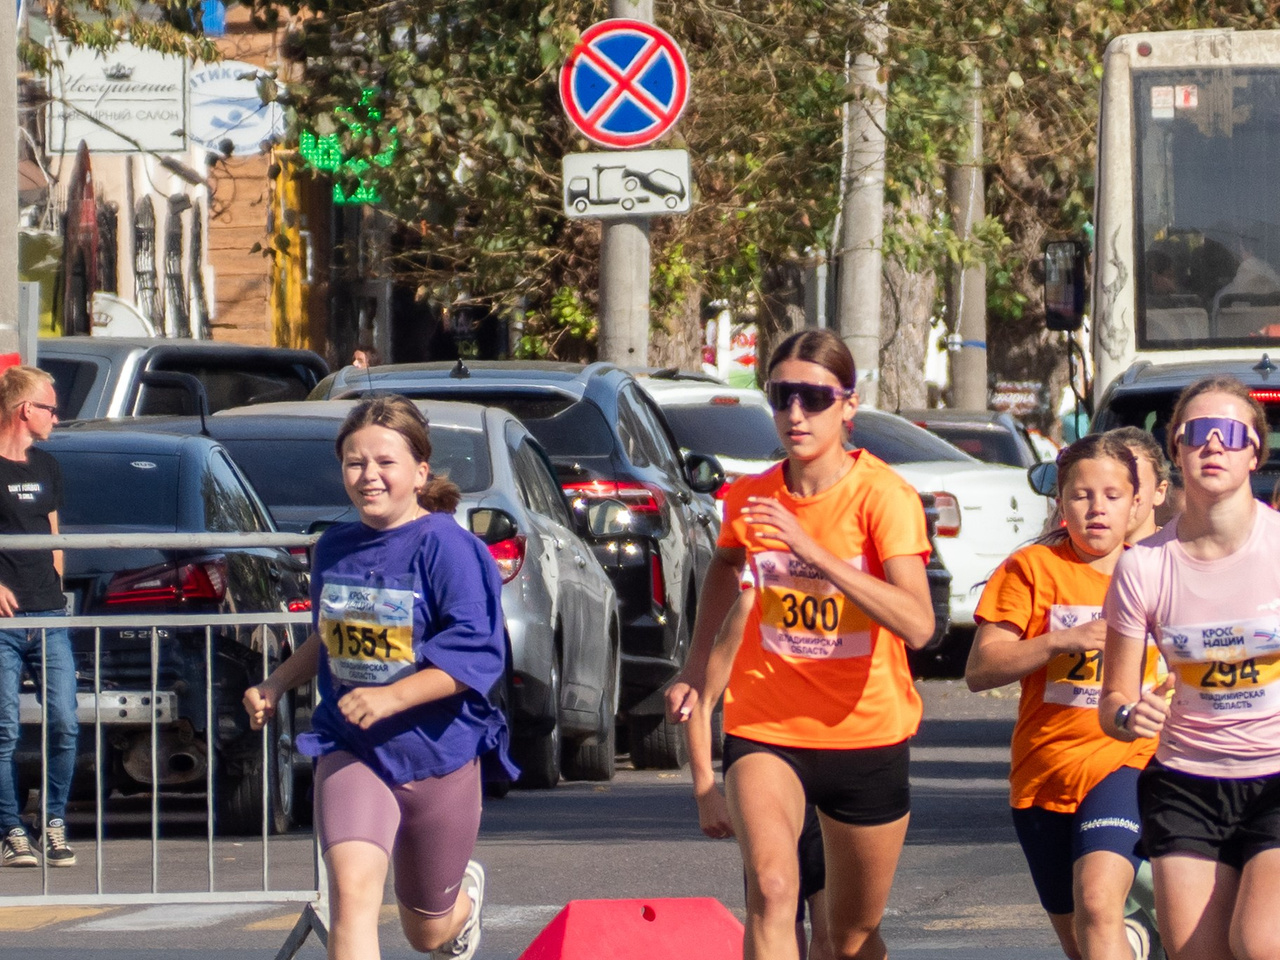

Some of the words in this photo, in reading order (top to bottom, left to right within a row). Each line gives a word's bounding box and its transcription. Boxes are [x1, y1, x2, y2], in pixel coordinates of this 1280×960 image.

[135, 109, 179, 121] САЛОН
[781, 593, 839, 631] 300
[1202, 626, 1233, 638] КРОСС
[332, 622, 394, 658] 1551
[1203, 636, 1245, 648] НАЦИИ
[791, 645, 829, 655] ОБЛАСТЬ
[1200, 659, 1260, 687] 294
[1199, 689, 1265, 702] ВЛАДИМИРСКАЯ
[1213, 700, 1252, 710] ОБЛАСТЬ
